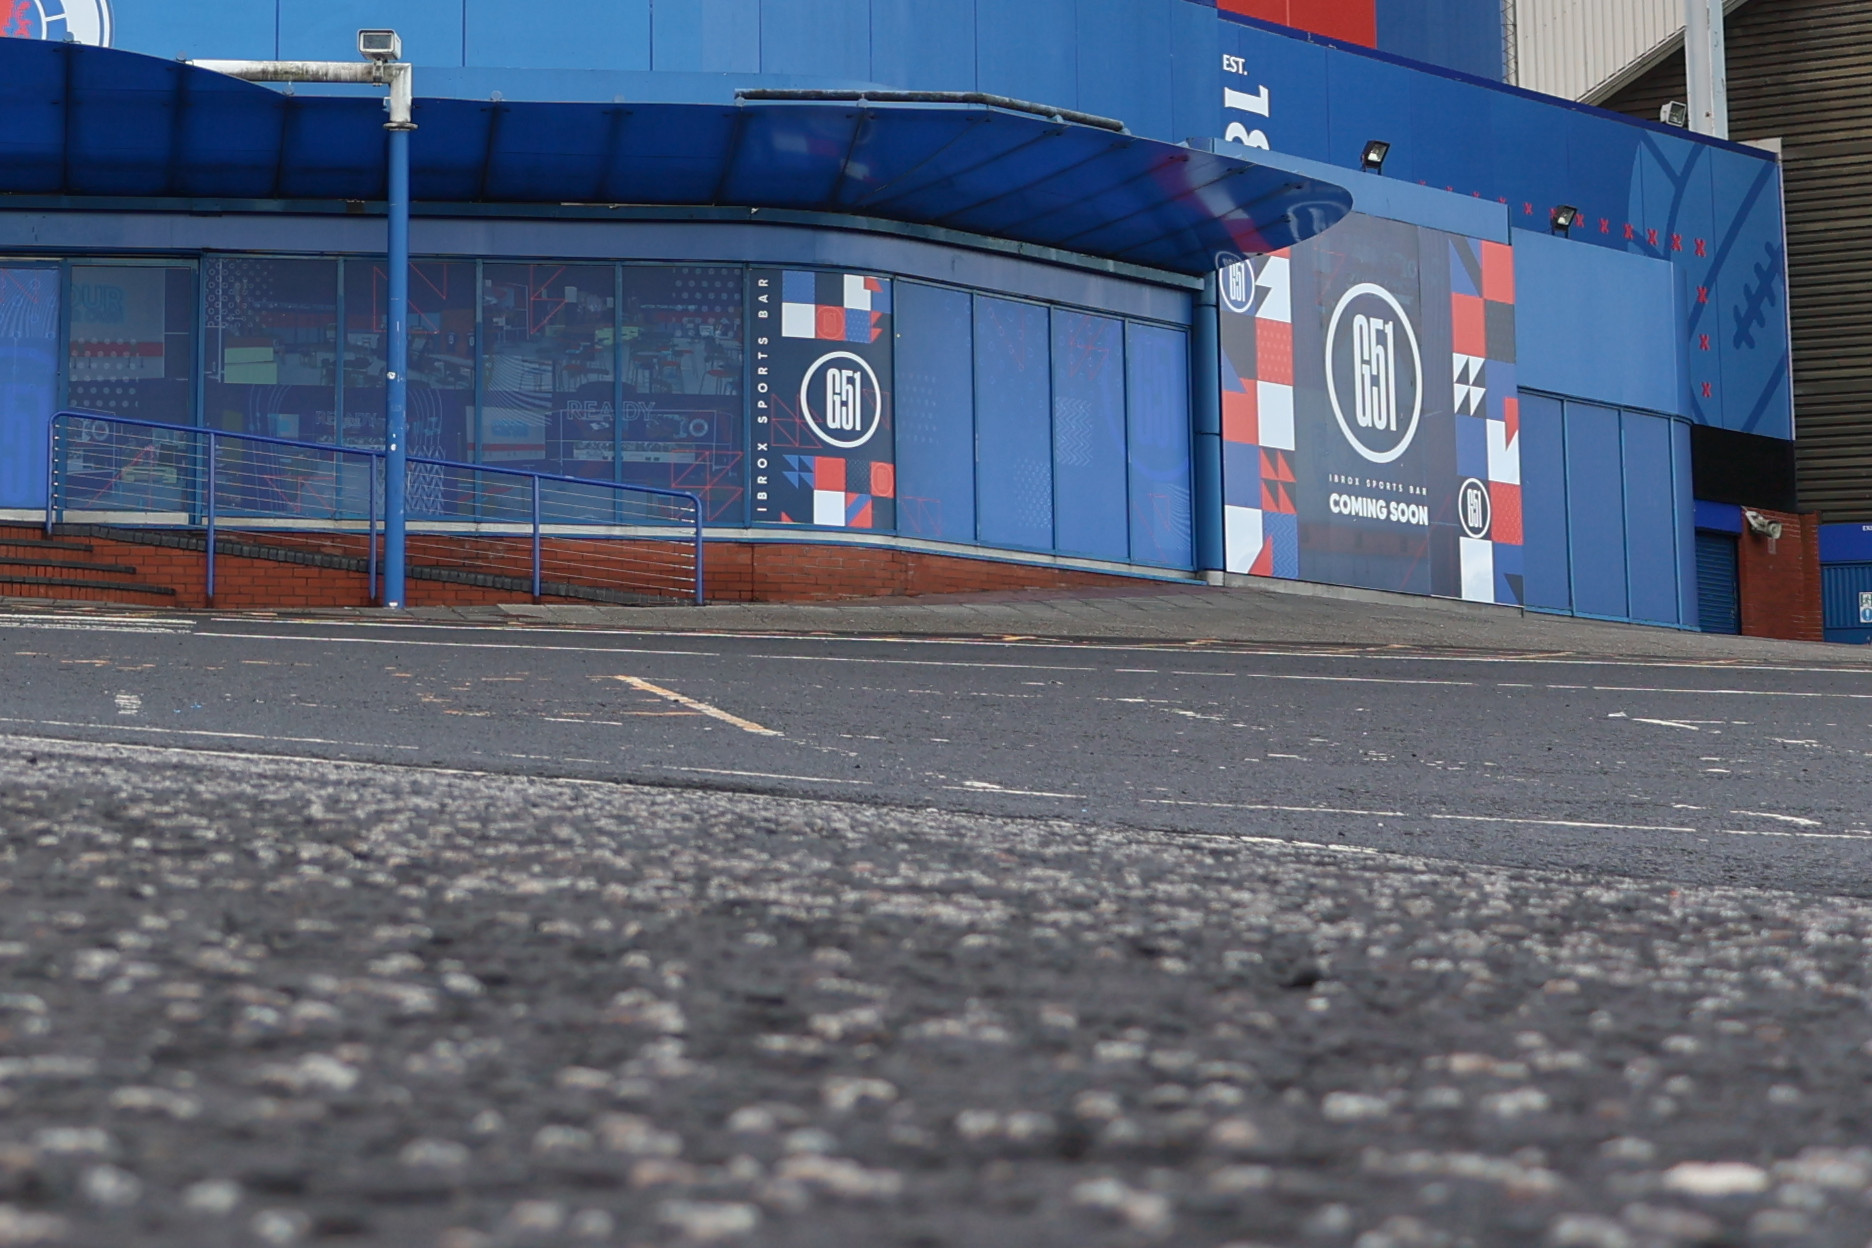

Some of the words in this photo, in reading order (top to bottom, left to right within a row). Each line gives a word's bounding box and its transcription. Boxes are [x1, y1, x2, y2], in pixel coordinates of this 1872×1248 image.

[1222, 54, 1248, 76] EST.
[757, 278, 769, 318] BAR
[1229, 262, 1246, 303] G51
[757, 336, 769, 424] SPORTS
[1352, 313, 1397, 432] G51
[826, 367, 862, 432] G51
[757, 442, 768, 512] IBROX
[1328, 473, 1360, 486] IBROX
[1365, 478, 1404, 493] SPORTS
[1409, 485, 1428, 497] BAR
[1329, 493, 1388, 520] COMING
[1389, 500, 1429, 526] SOON
[1466, 487, 1483, 528] G51
